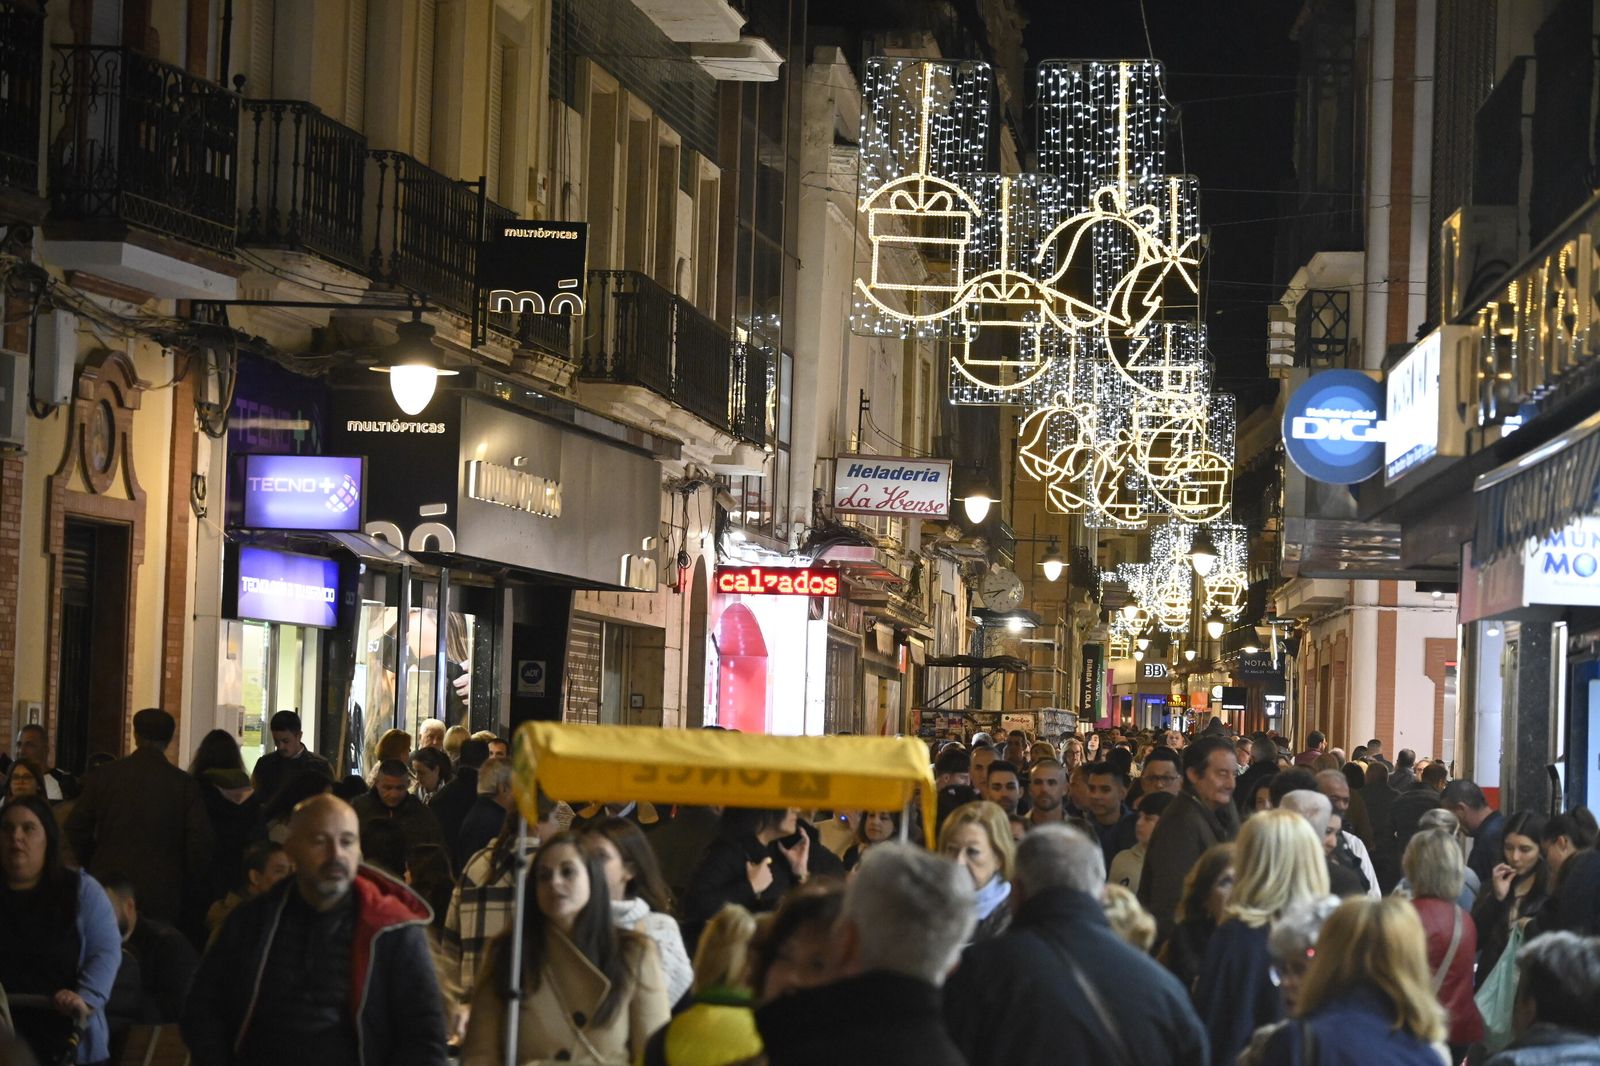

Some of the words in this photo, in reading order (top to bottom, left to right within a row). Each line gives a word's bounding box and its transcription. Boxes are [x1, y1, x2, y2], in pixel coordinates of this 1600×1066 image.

[490, 279, 583, 315] mó
[838, 483, 871, 508] La
[720, 569, 838, 594] calzados
